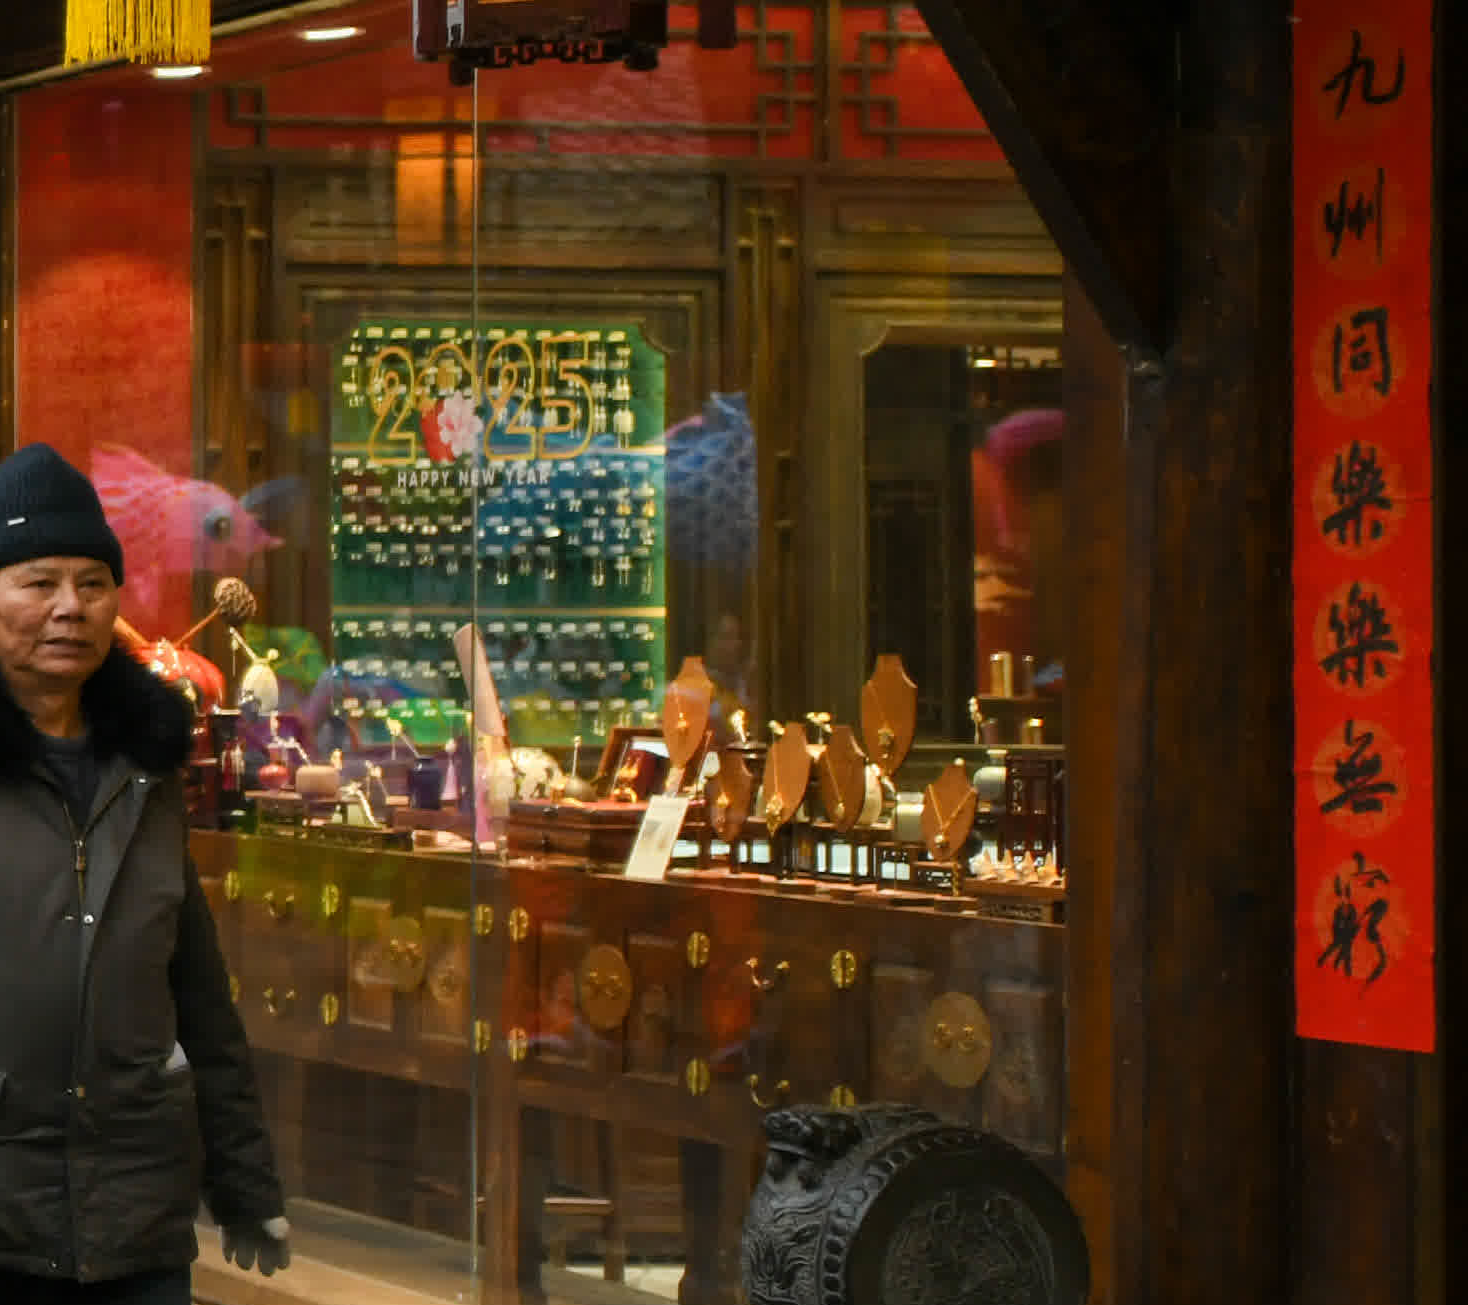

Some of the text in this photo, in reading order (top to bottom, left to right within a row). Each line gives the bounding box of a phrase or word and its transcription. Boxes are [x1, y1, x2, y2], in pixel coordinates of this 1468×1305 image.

[397, 469, 549, 488] HAPPY NEW YEAR
